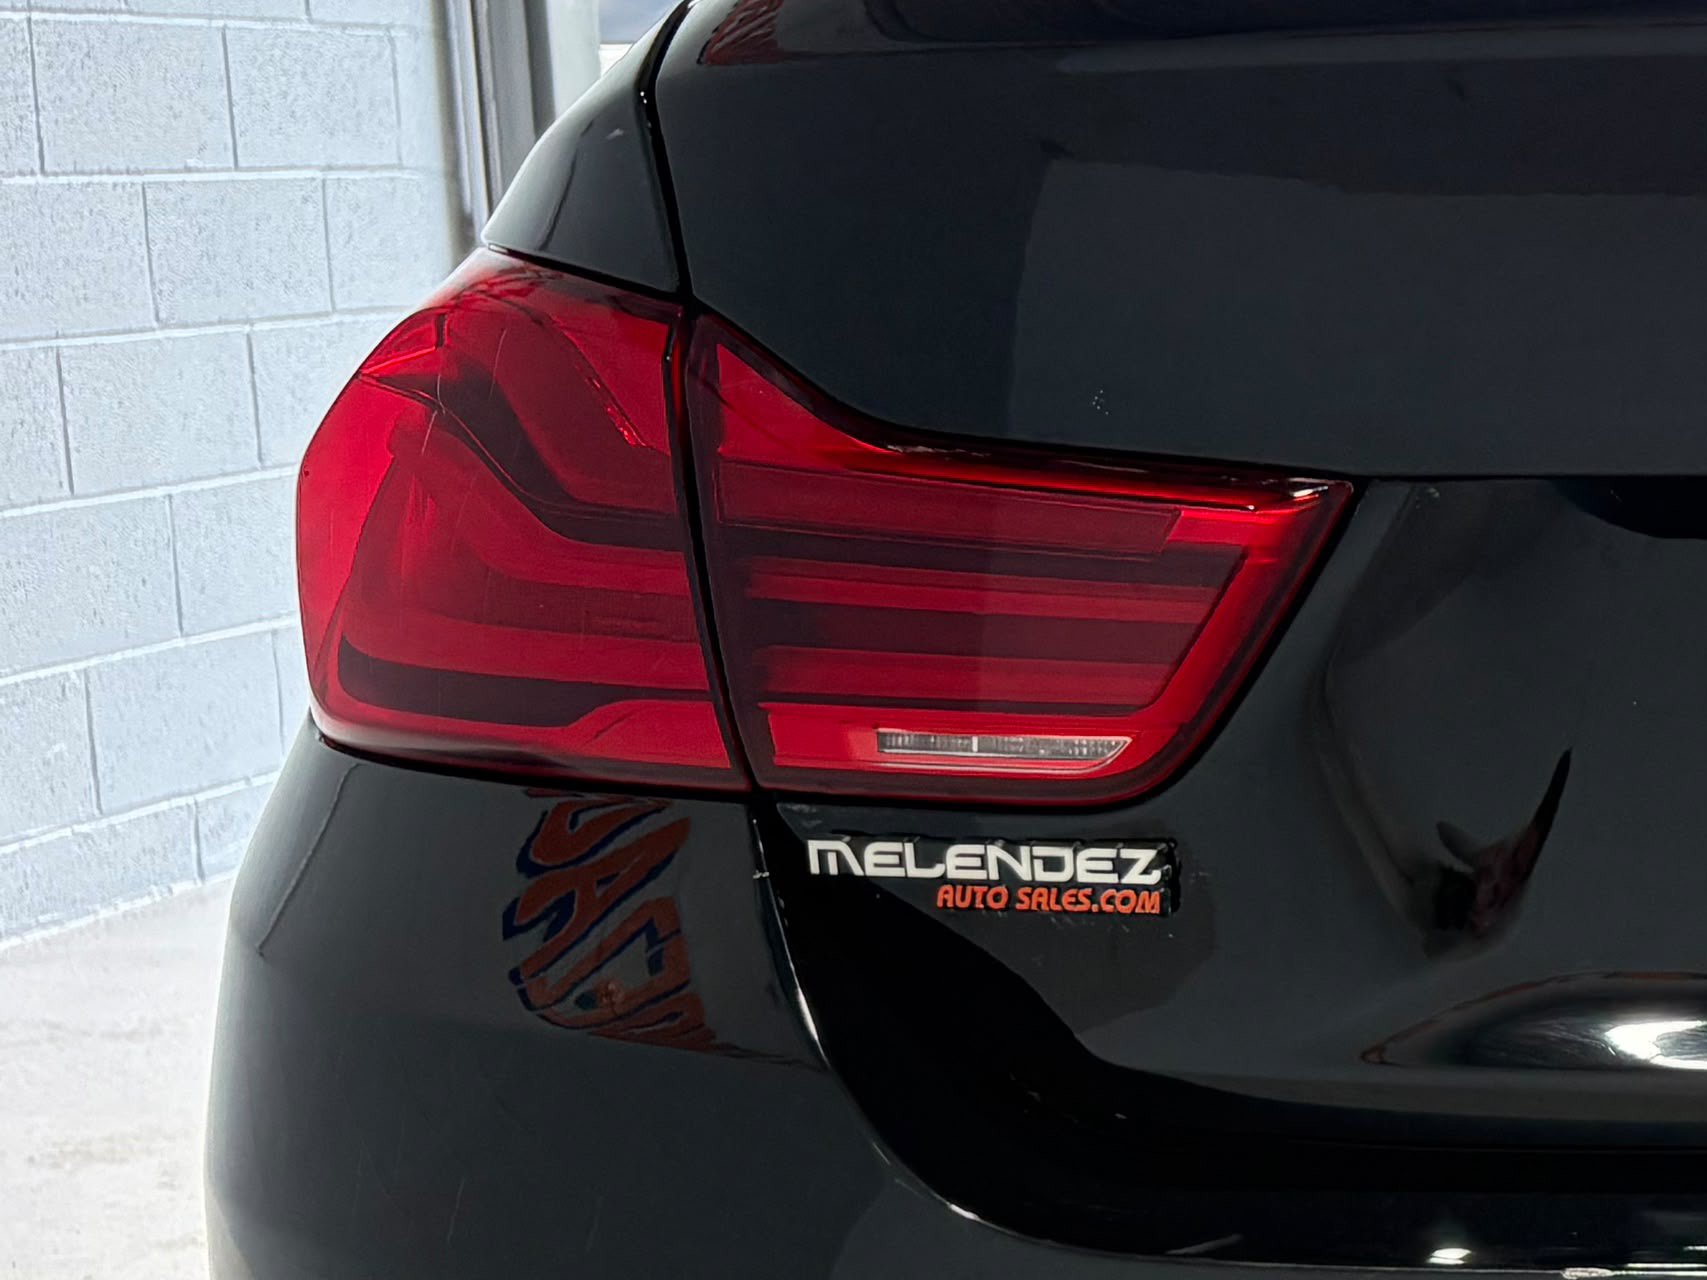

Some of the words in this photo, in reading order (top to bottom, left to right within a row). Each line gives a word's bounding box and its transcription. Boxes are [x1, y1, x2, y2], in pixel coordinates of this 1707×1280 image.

[808, 839, 1161, 884] MELENDEZ
[937, 884, 1009, 910] AUTO
[1015, 887, 1161, 914] SALES.COM
